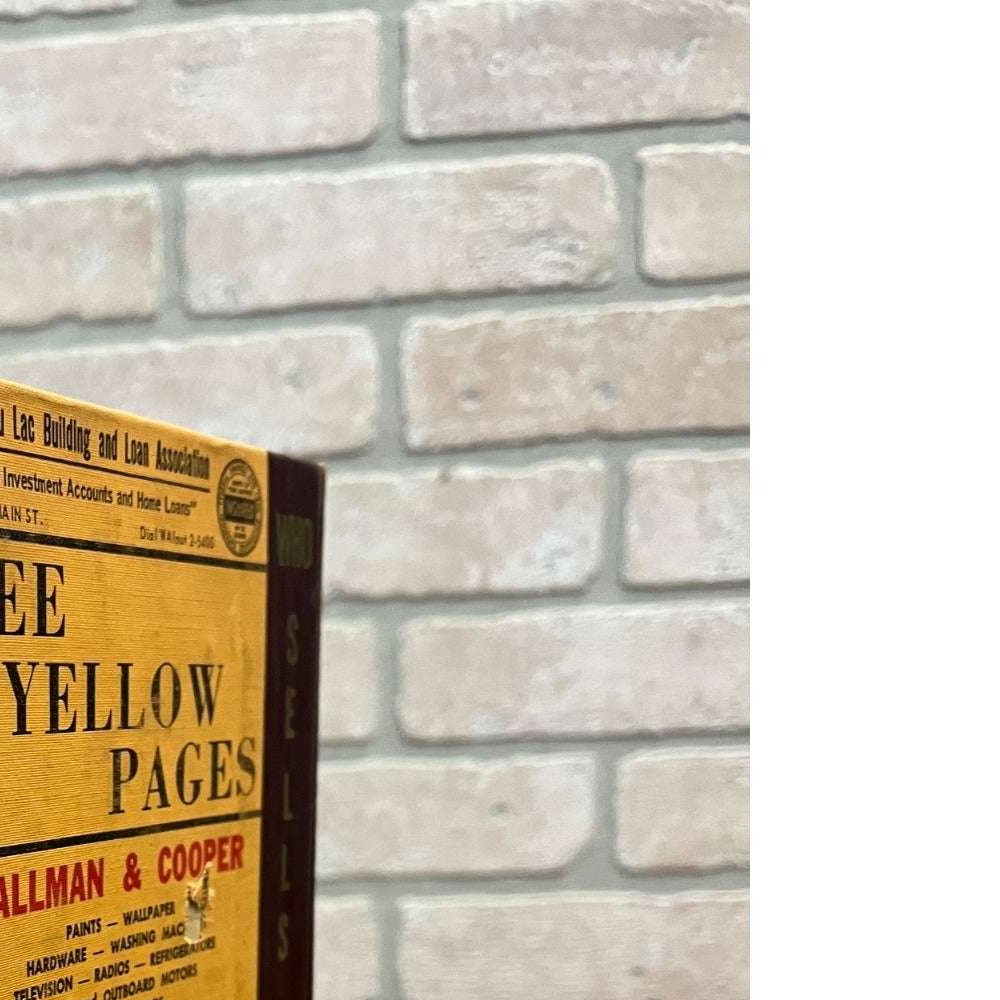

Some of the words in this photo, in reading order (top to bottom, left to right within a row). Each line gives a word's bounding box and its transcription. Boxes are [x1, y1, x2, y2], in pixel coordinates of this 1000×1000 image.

[13, 405, 35, 443] Lac
[43, 412, 91, 461] Building
[99, 429, 118, 461] and
[125, 433, 149, 467] Loan
[156, 440, 210, 480] Association
[3, 467, 63, 497] Investment
[67, 478, 113, 504] Accounts
[117, 490, 133, 507] and
[137, 486, 161, 512] Home
[25, 508, 44, 525] ST.
[2, 661, 224, 736] YELLOW
[108, 736, 256, 815] PAGES
[122, 852, 142, 893] &
[158, 834, 245, 884] COOPER
[66, 918, 102, 940] PAINTS
[123, 901, 176, 926] WALLPAPER
[27, 947, 88, 977] HARDWARE
[110, 930, 156, 954] WASHING
[94, 960, 130, 983] RADIOS
[150, 936, 216, 966] REFRIGERATORS
[160, 963, 198, 986] MOTORS
